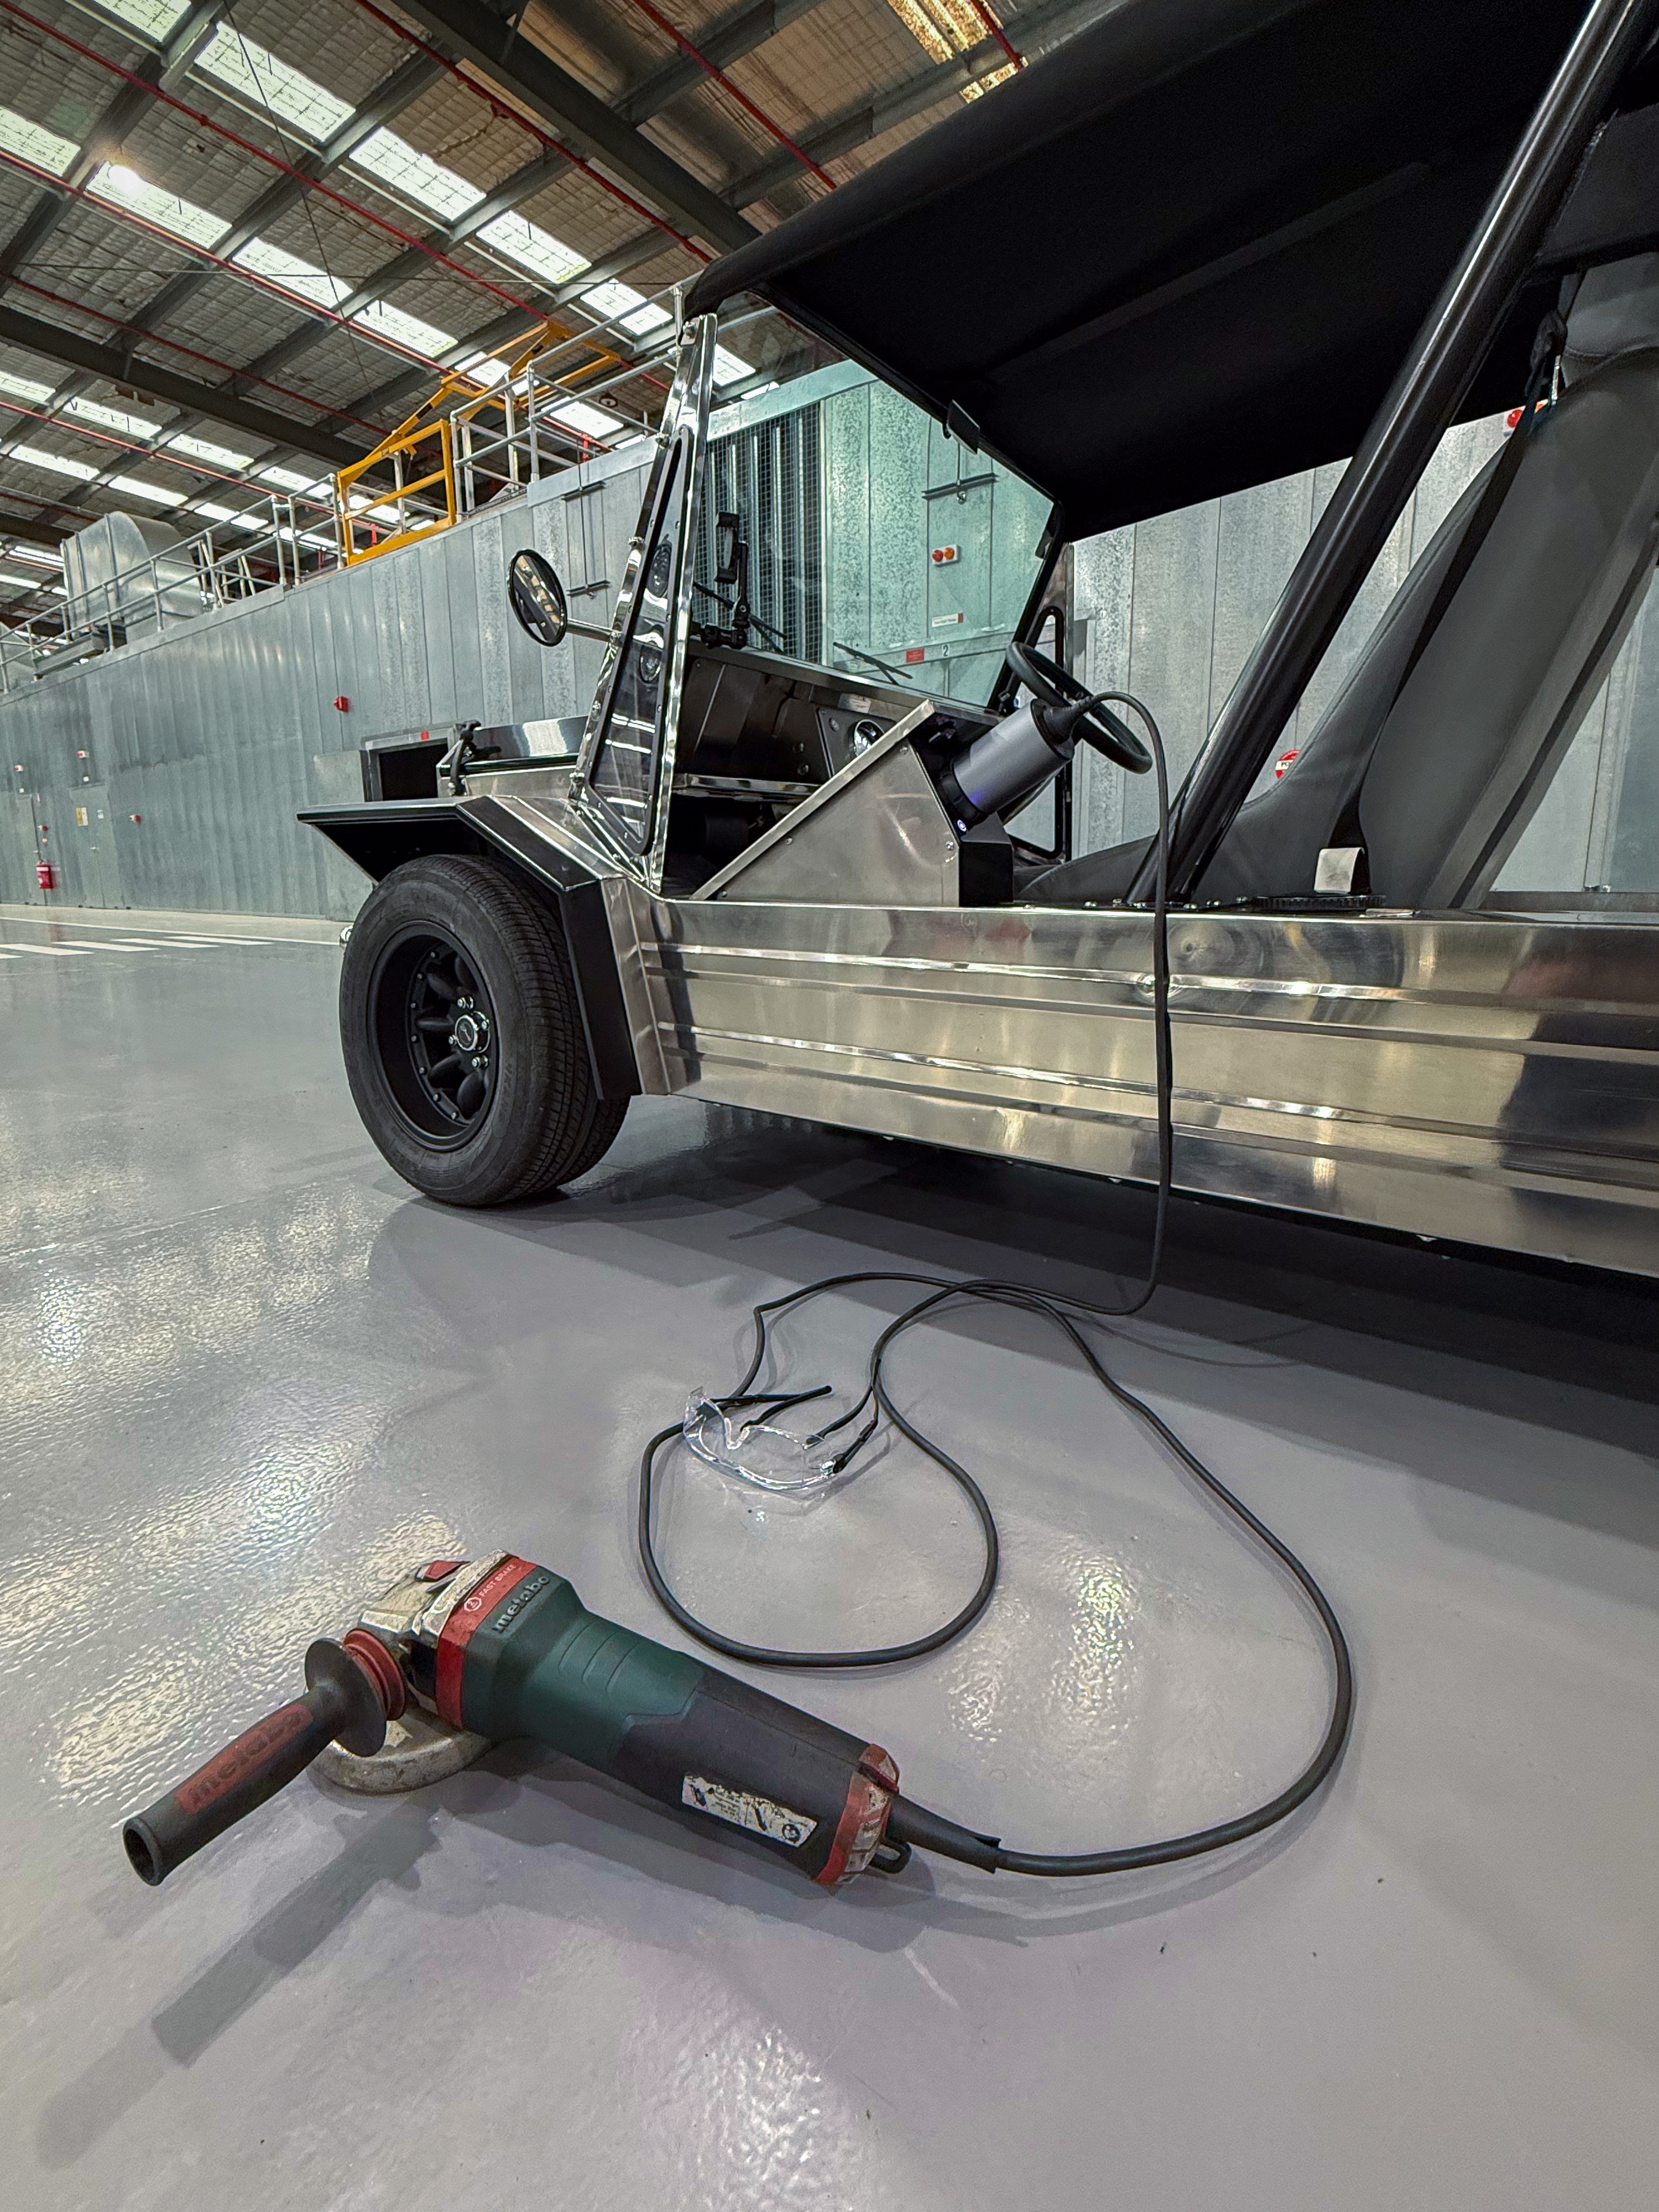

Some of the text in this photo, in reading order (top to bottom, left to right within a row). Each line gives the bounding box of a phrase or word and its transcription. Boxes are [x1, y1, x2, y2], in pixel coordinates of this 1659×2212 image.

[943, 645, 948, 657] 2
[479, 1564, 516, 1597] FAST BRAKE
[492, 1577, 550, 1634] metabo
